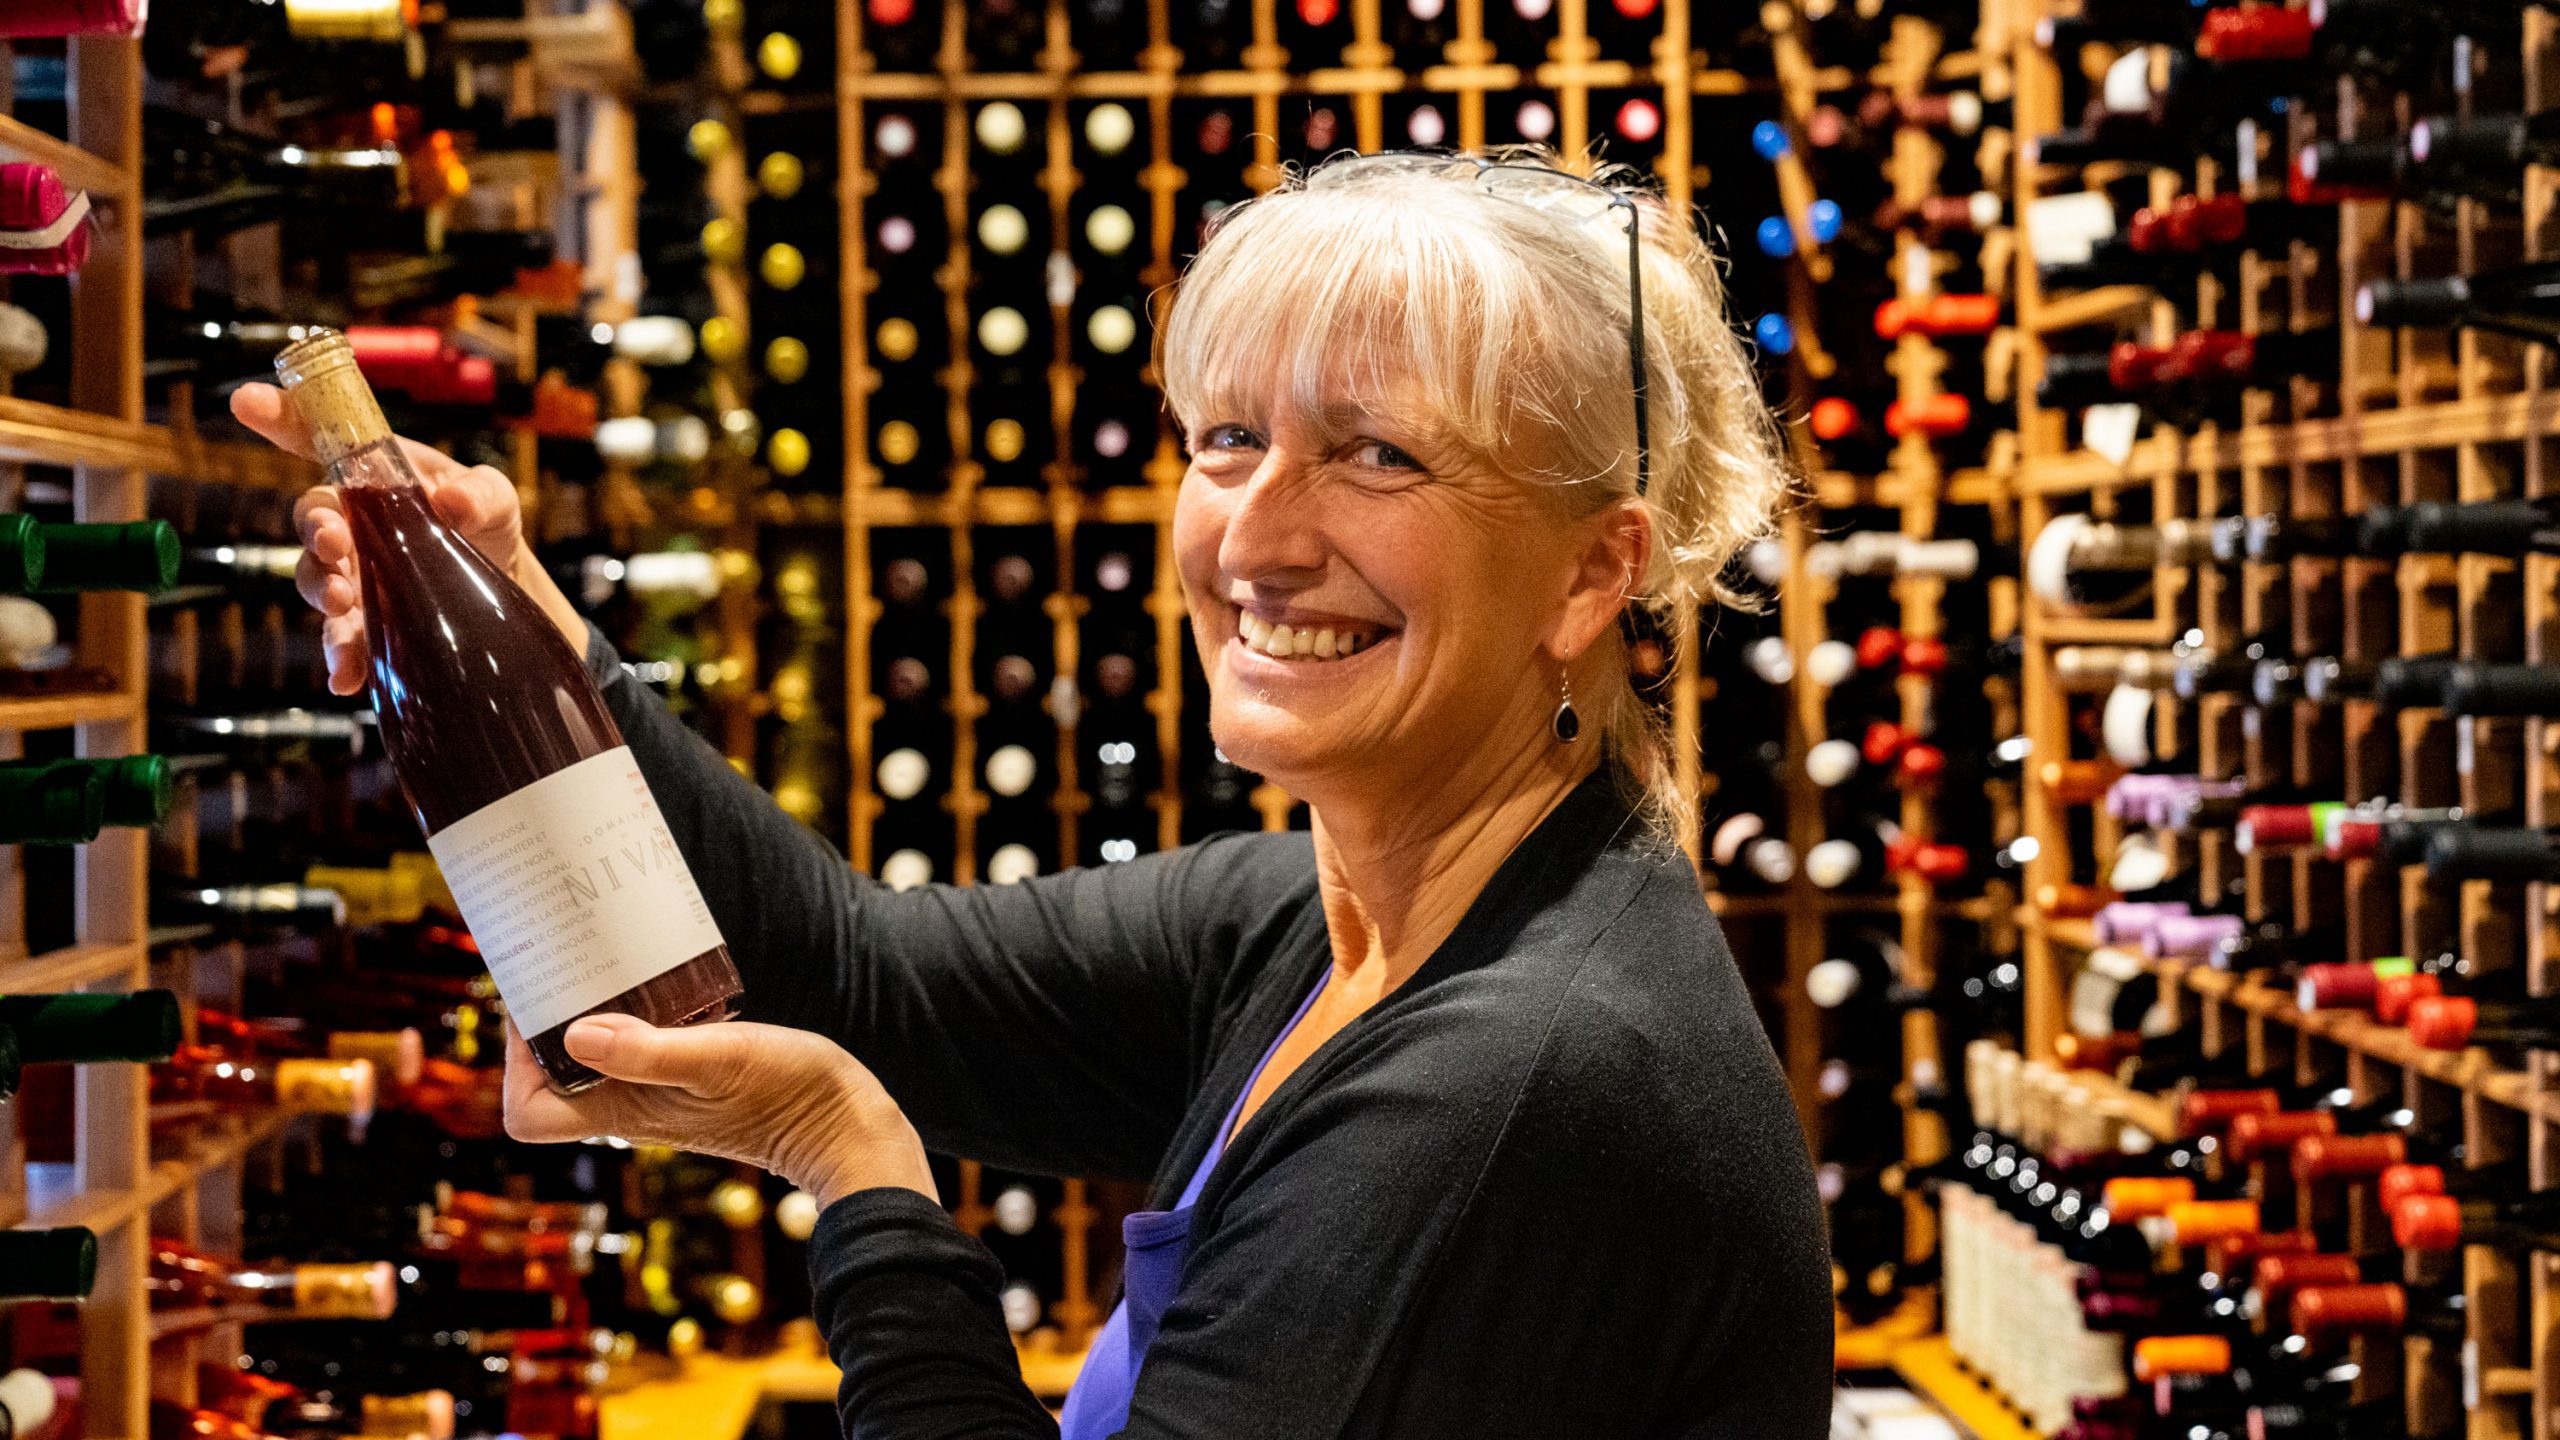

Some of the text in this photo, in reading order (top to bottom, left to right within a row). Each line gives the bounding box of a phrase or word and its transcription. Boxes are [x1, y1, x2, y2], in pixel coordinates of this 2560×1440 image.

[489, 820, 527, 845] POUSSE
[535, 831, 548, 843] ET
[524, 847, 555, 869] NOUS
[492, 886, 519, 905] ALORS
[512, 905, 523, 916] LE
[538, 909, 553, 922] LA
[535, 933, 546, 944] SE
[546, 907, 597, 938] COMPOSE
[543, 959, 573, 980] ESSAIS
[573, 951, 589, 965] AU
[554, 975, 581, 994] DANS
[581, 969, 594, 981] LE
